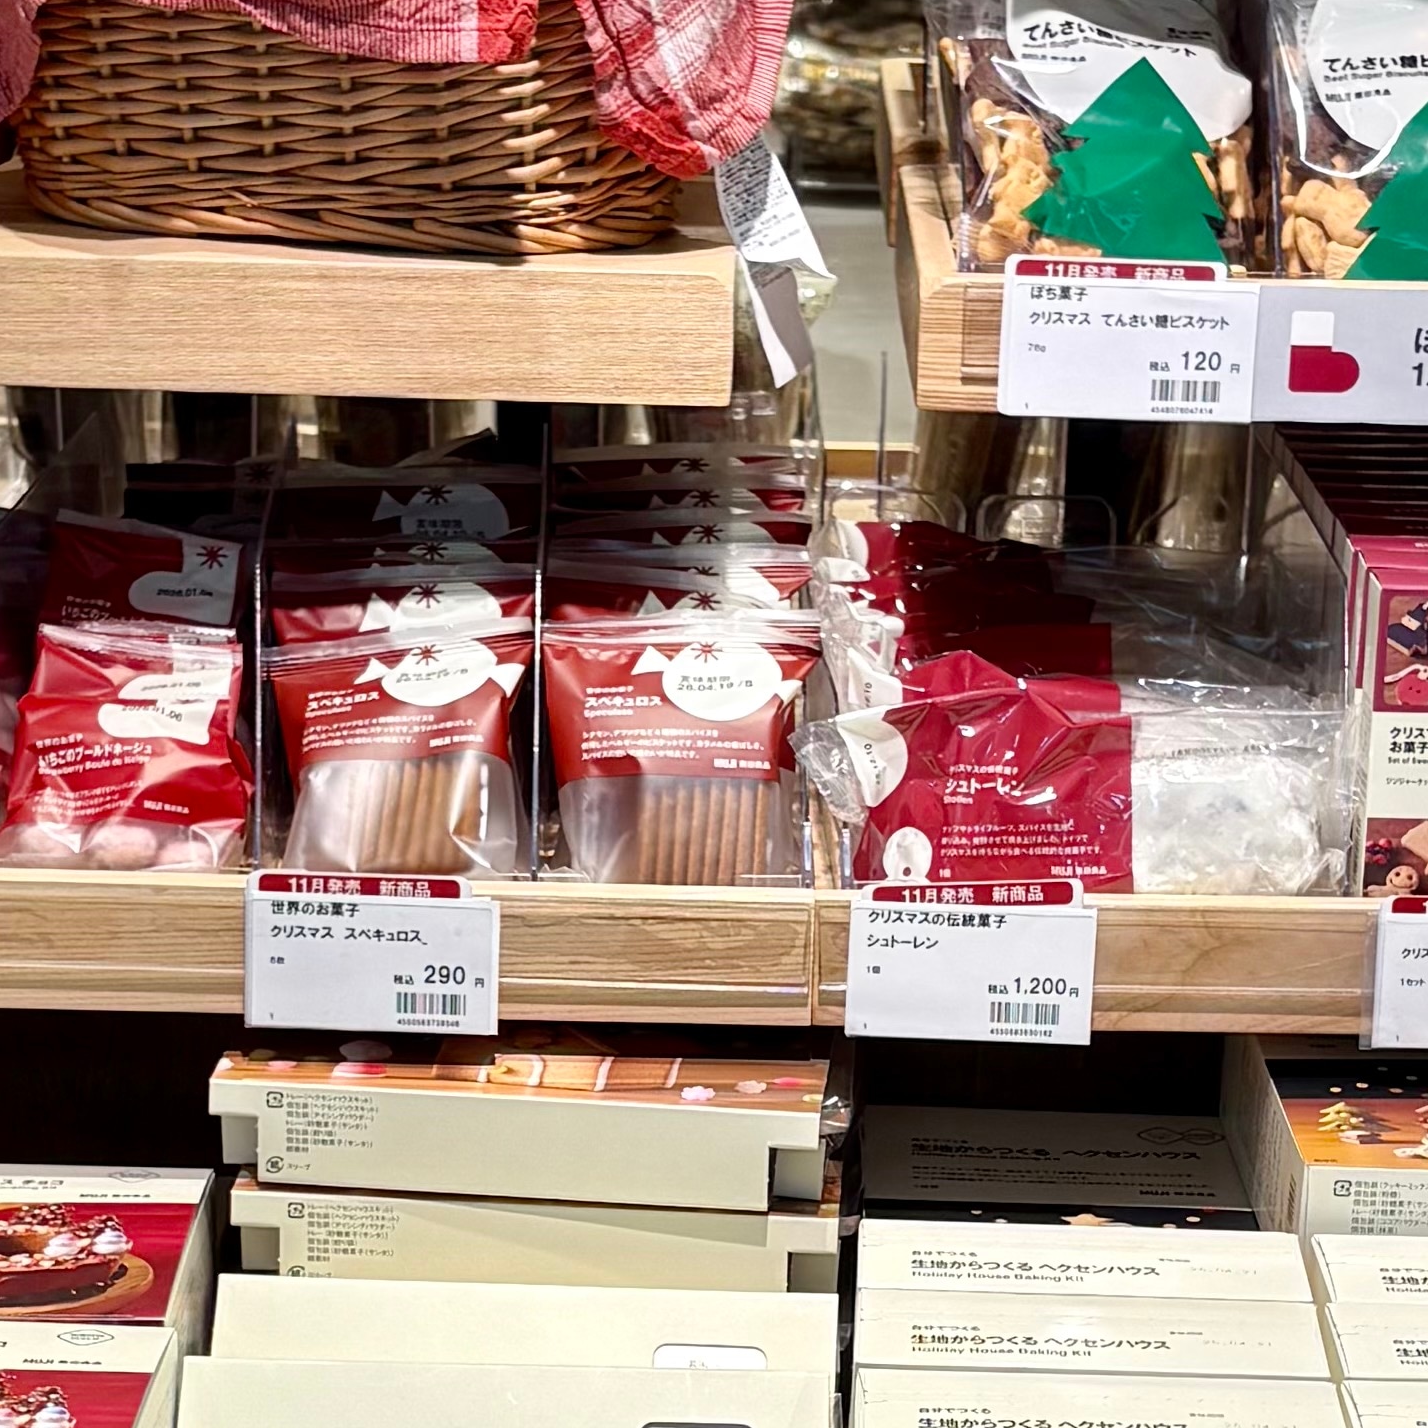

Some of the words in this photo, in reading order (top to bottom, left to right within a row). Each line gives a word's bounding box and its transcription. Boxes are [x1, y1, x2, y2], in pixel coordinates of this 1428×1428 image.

[1029, 311, 1091, 326] クリスマス
[1181, 351, 1223, 372] 120
[902, 887, 975, 906] 11月発売
[991, 885, 1045, 904] 新商品
[270, 900, 360, 919] 世界のお菓子
[868, 908, 1007, 930] クリスマスの伝統菓子
[269, 925, 335, 942] クリスマス
[866, 932, 939, 951] シュトーレン
[423, 964, 466, 987] 290
